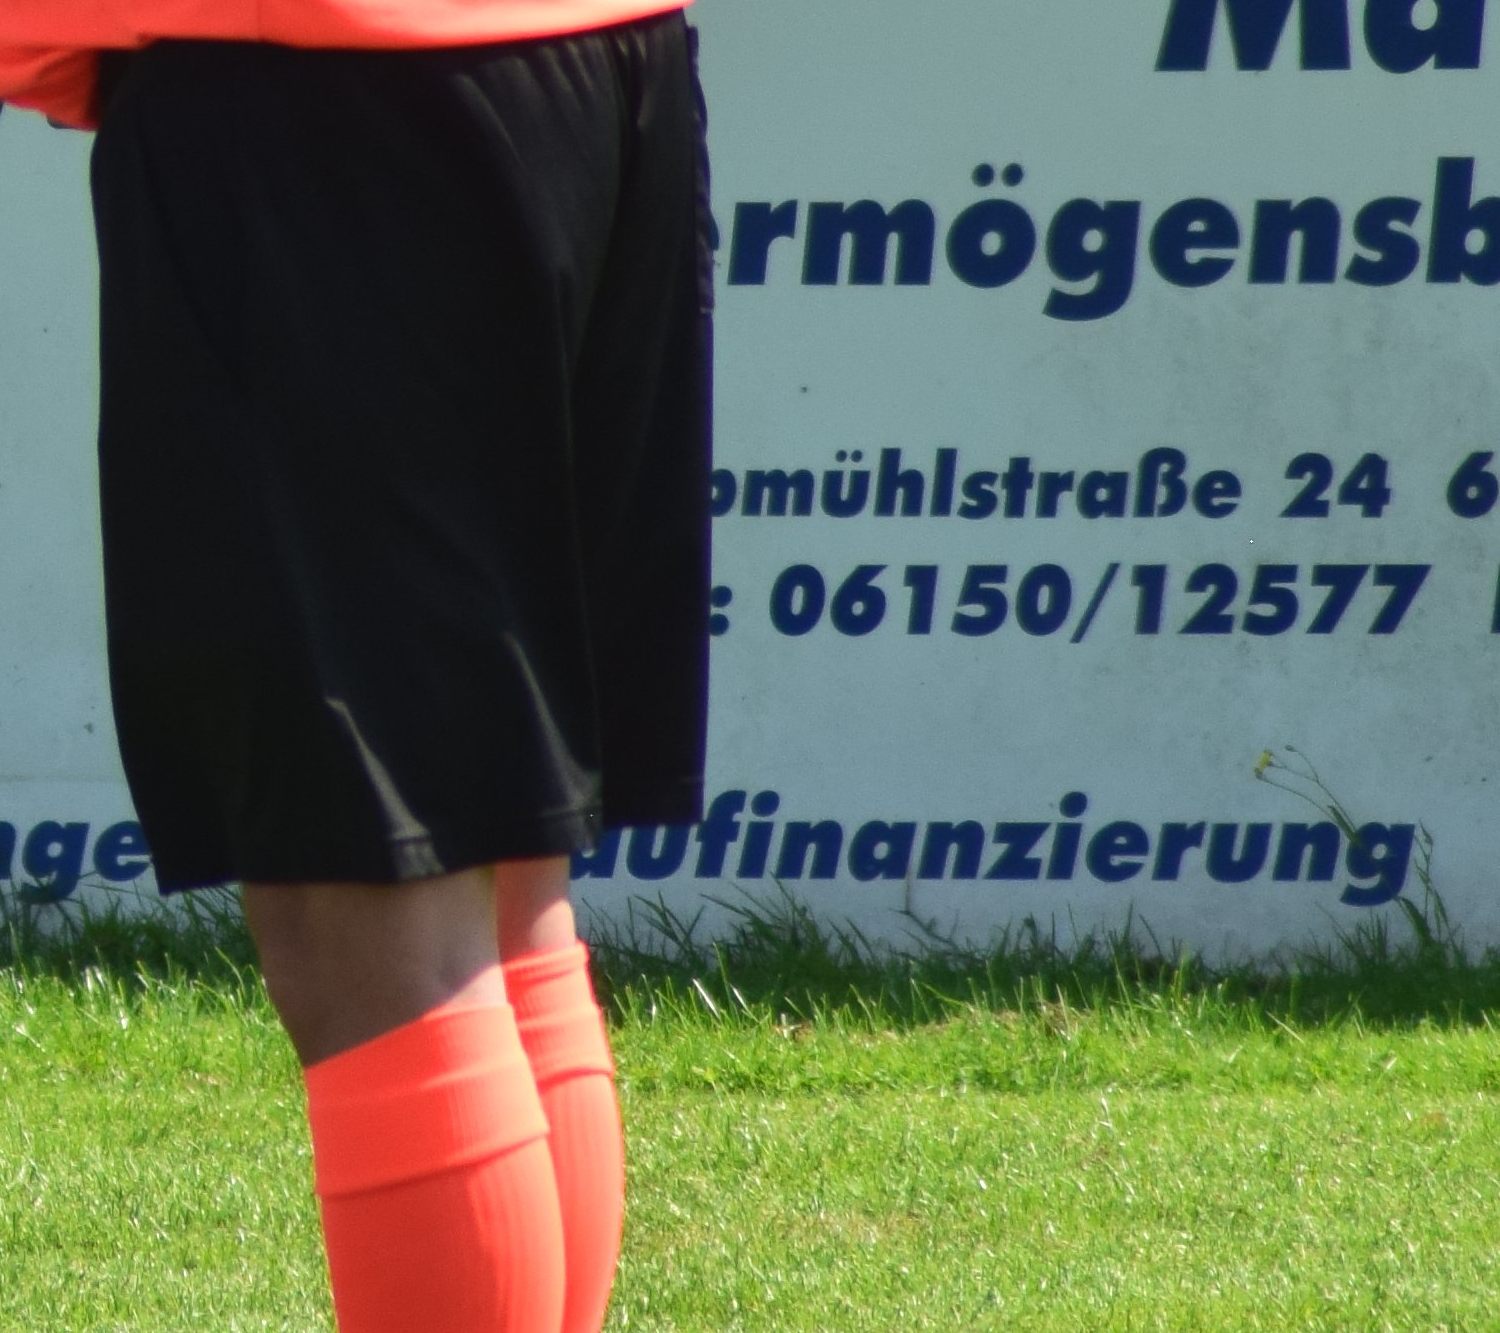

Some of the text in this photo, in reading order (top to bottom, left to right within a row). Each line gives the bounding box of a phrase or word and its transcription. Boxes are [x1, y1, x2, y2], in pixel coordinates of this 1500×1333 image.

[709, 156, 1500, 322] rmögensb
[1278, 451, 1392, 519] 24
[769, 563, 1433, 644] 06150/12577
